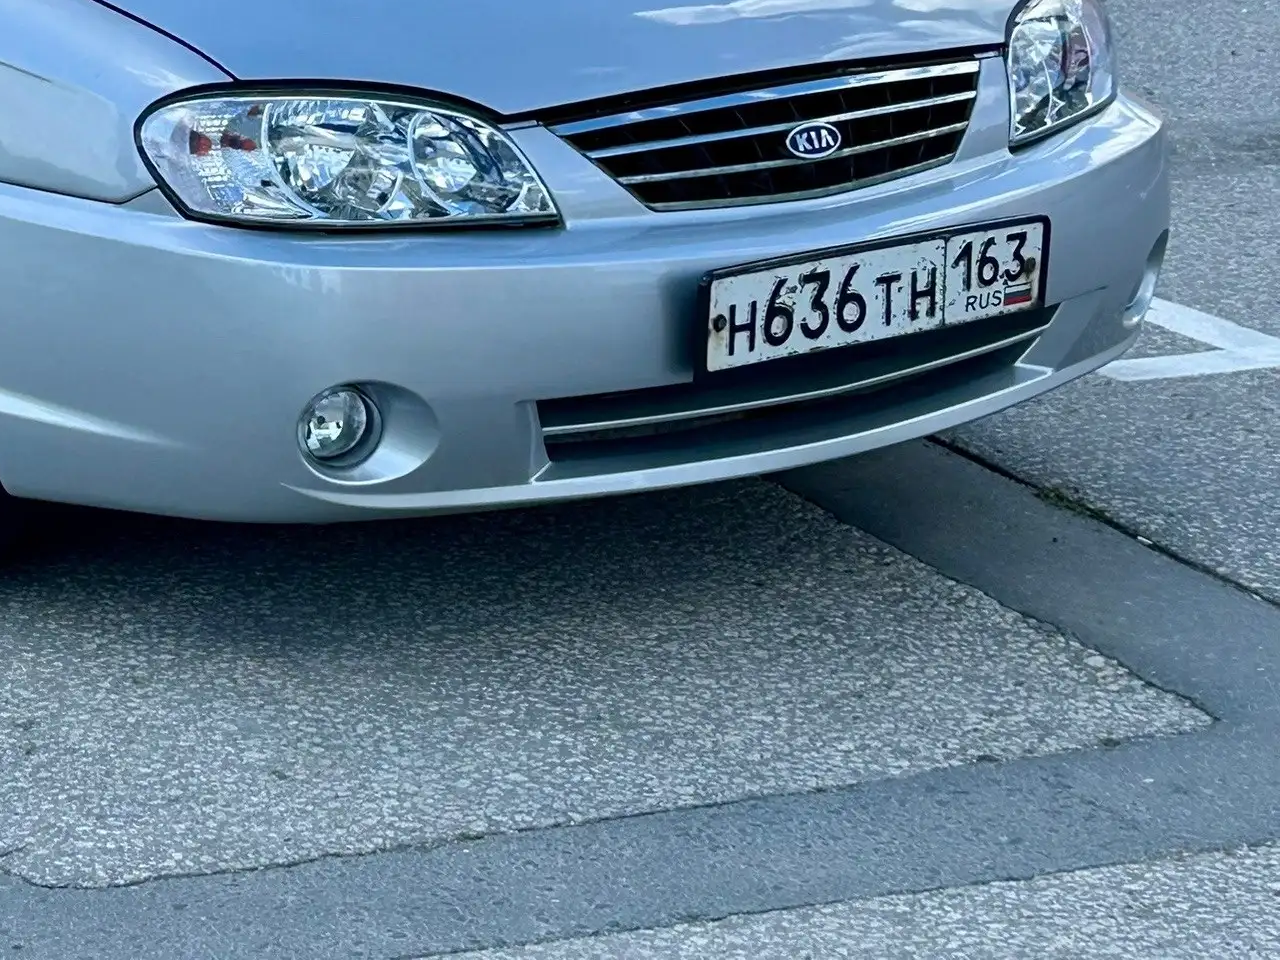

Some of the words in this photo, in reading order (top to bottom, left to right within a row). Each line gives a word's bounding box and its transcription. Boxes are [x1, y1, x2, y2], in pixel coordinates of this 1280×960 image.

[795, 128, 835, 152] KIA
[951, 231, 1029, 292] 163
[965, 290, 1002, 312] RUS
